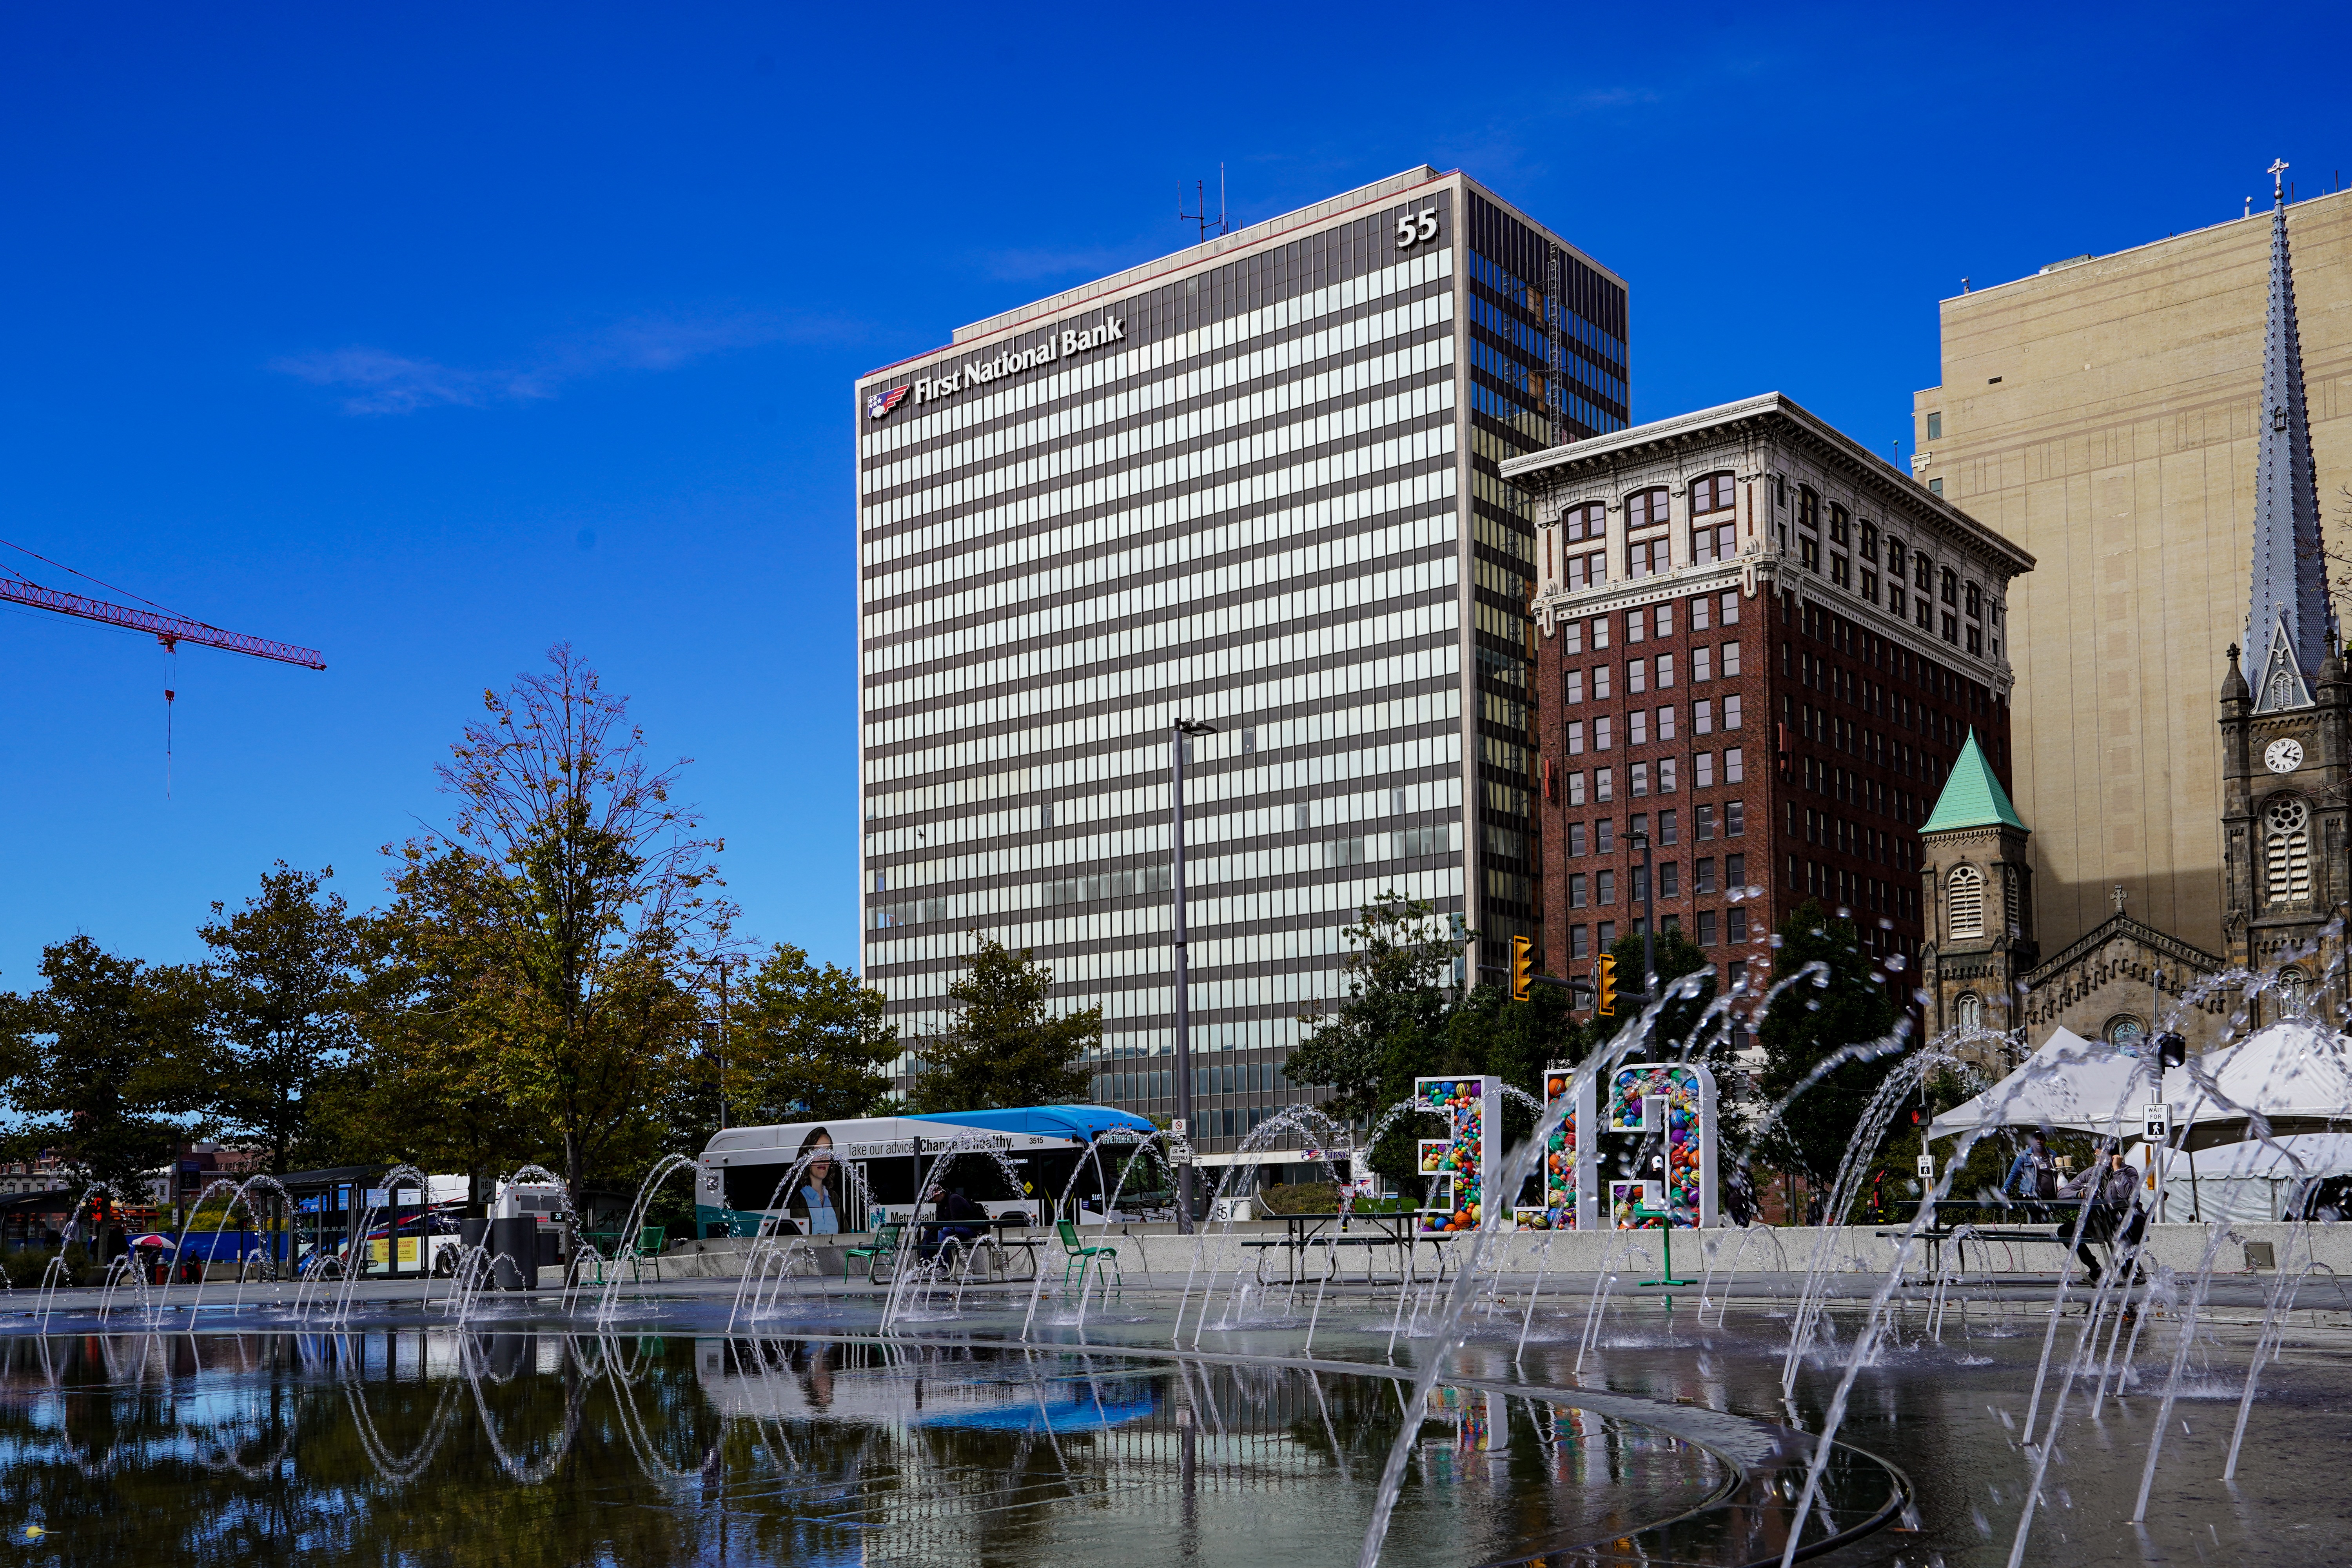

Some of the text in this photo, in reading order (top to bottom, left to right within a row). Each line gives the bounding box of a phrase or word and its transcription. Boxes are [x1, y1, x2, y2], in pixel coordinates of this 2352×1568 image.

[1397, 207, 1437, 247] 55
[914, 315, 1124, 404] First National Bank
[848, 1143, 867, 1156] Take
[869, 1144, 884, 1155] our
[886, 1140, 914, 1154] advice
[1325, 1149, 1347, 1159] First
[1217, 1204, 1227, 1220] 55
